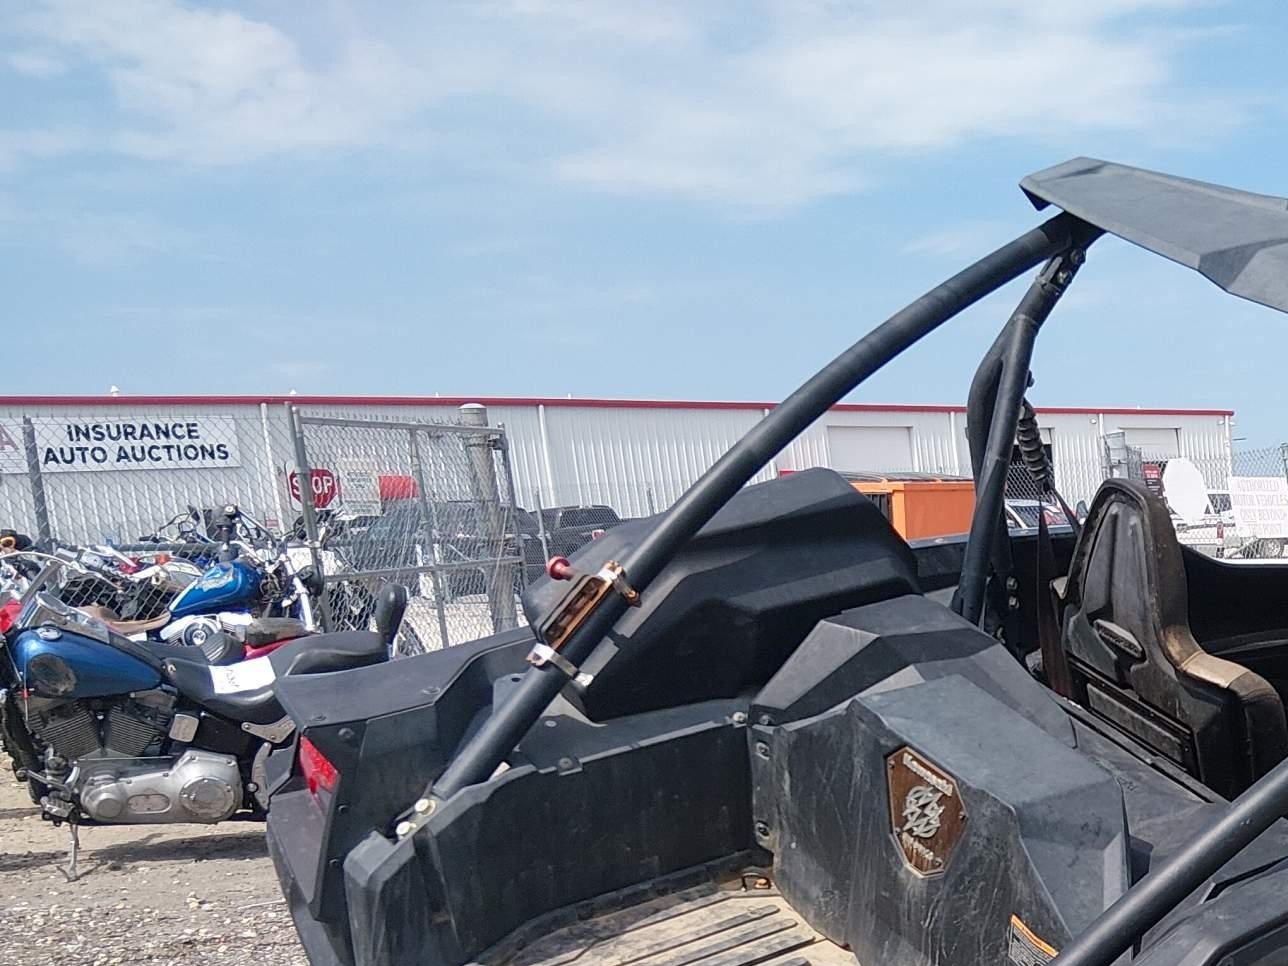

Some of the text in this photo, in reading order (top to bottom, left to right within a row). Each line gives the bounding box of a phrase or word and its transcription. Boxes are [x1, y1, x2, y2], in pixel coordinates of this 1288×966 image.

[67, 423, 200, 441] INSURANCE
[44, 443, 229, 465] AUTO AUCTIONS
[292, 476, 332, 494] SOP
